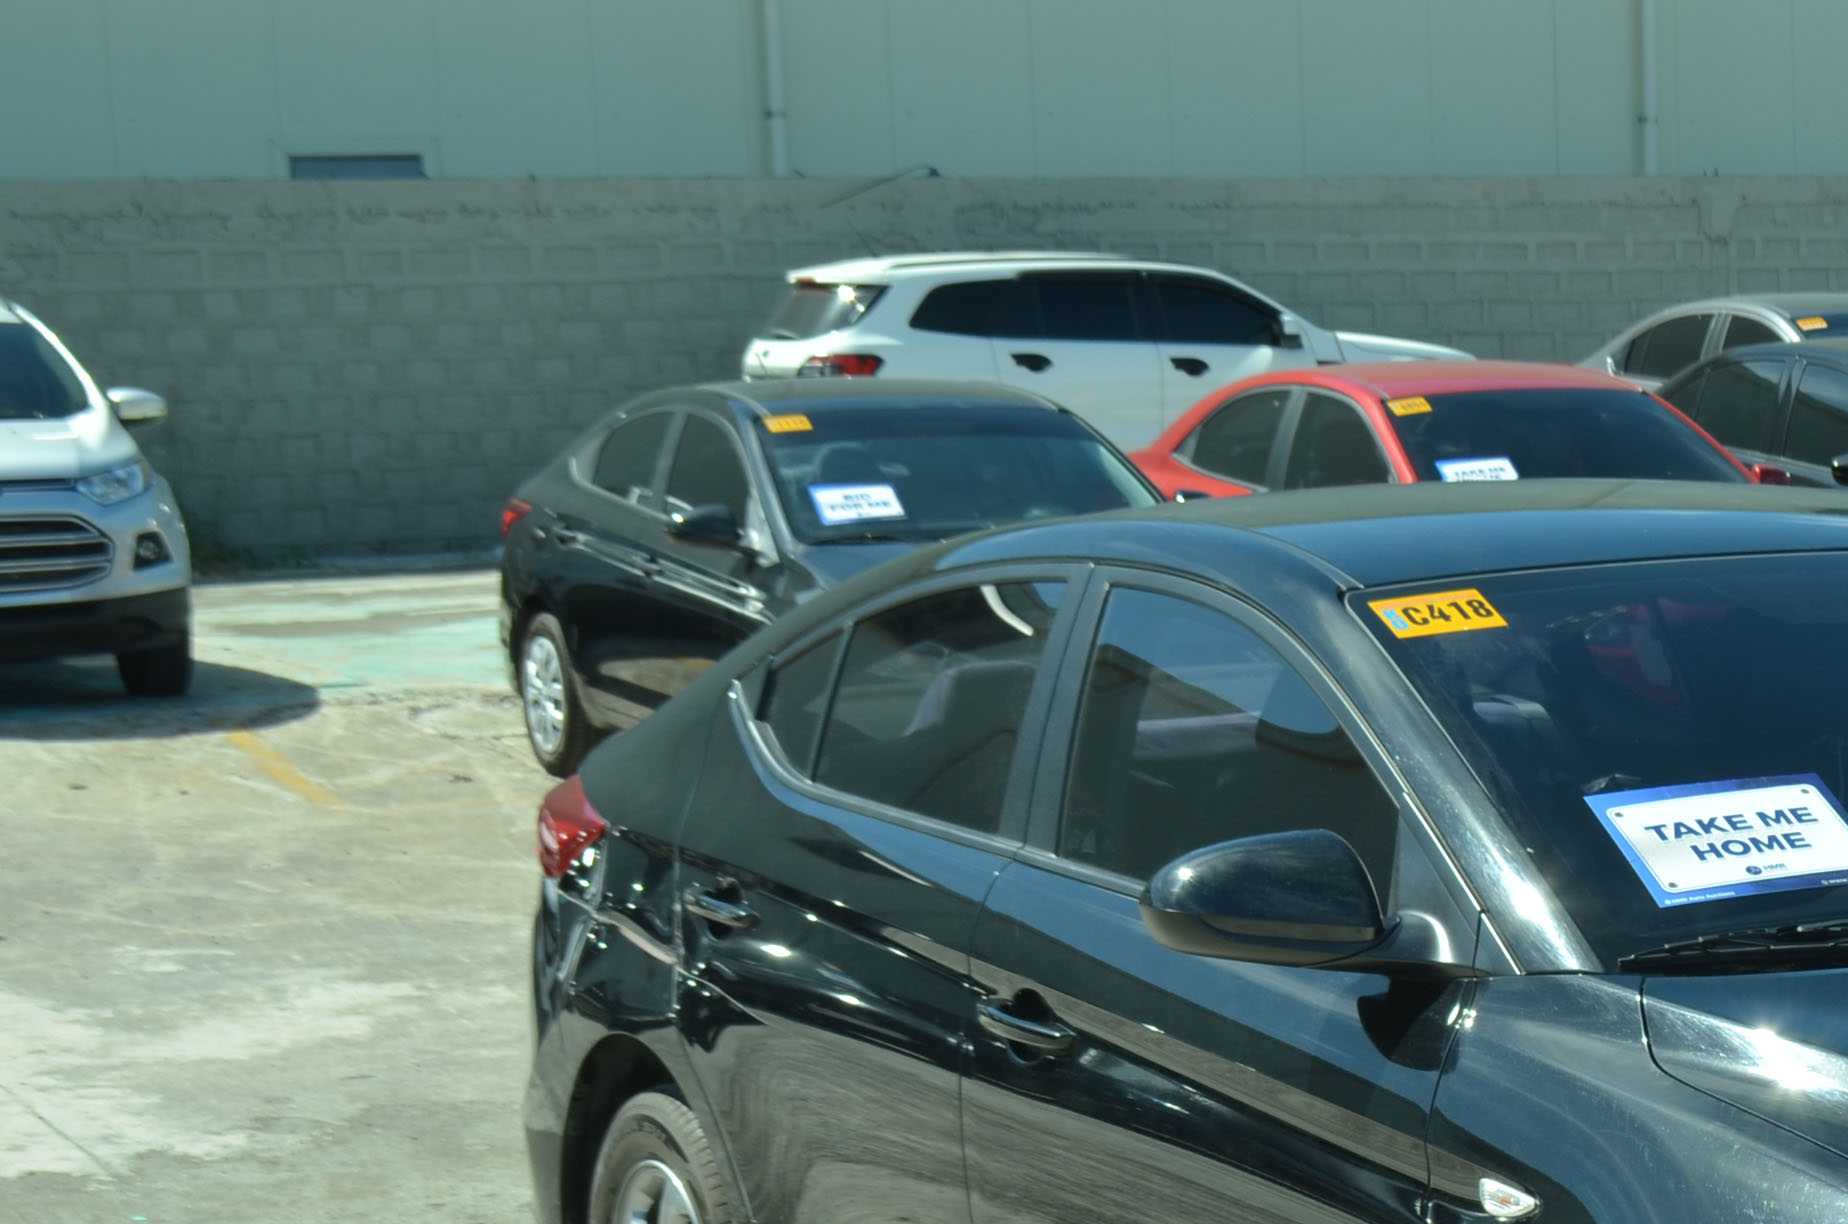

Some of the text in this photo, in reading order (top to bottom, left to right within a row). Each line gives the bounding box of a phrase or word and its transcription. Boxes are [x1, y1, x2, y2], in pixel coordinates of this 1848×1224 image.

[1401, 599, 1494, 626] C418
[1644, 806, 1819, 842] TAKE ME
[1690, 831, 1812, 861] HOME
